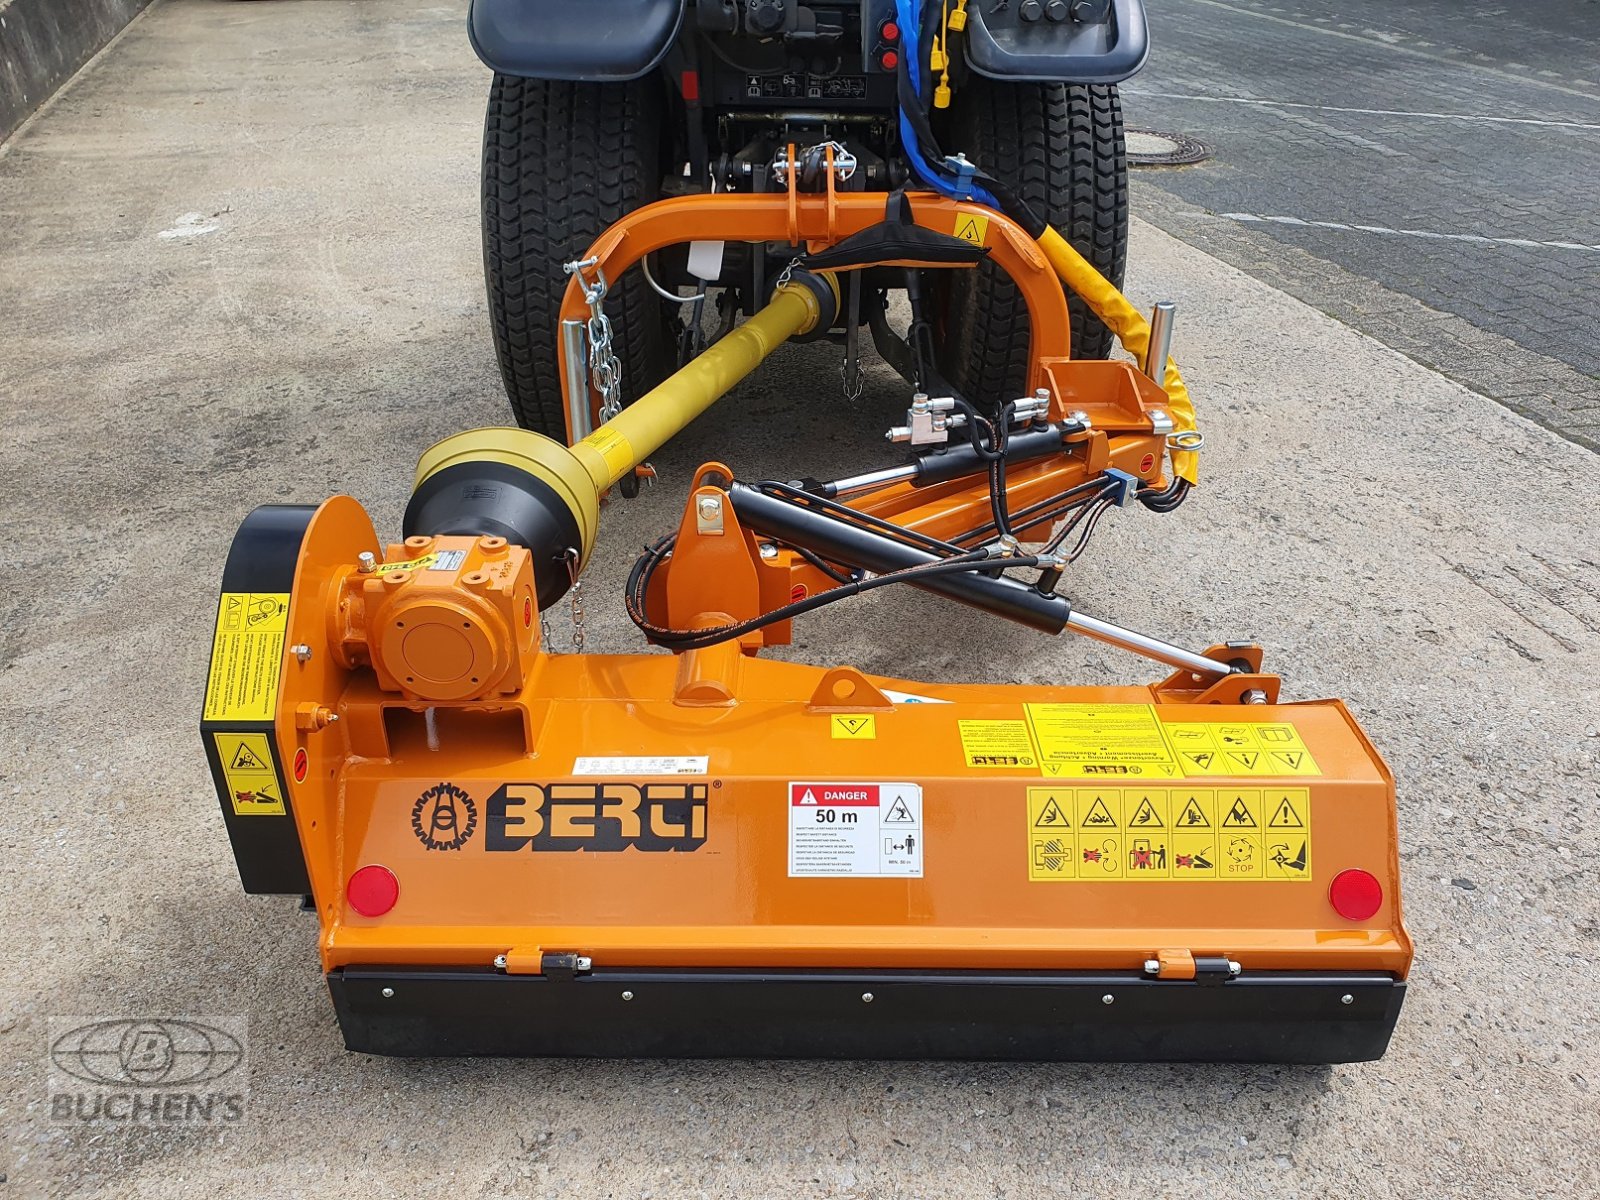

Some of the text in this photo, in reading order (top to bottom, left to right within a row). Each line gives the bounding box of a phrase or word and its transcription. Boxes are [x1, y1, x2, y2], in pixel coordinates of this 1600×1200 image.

[824, 791, 868, 800] DANGER
[816, 809, 858, 823] 50 m
[1228, 864, 1254, 873] STOP
